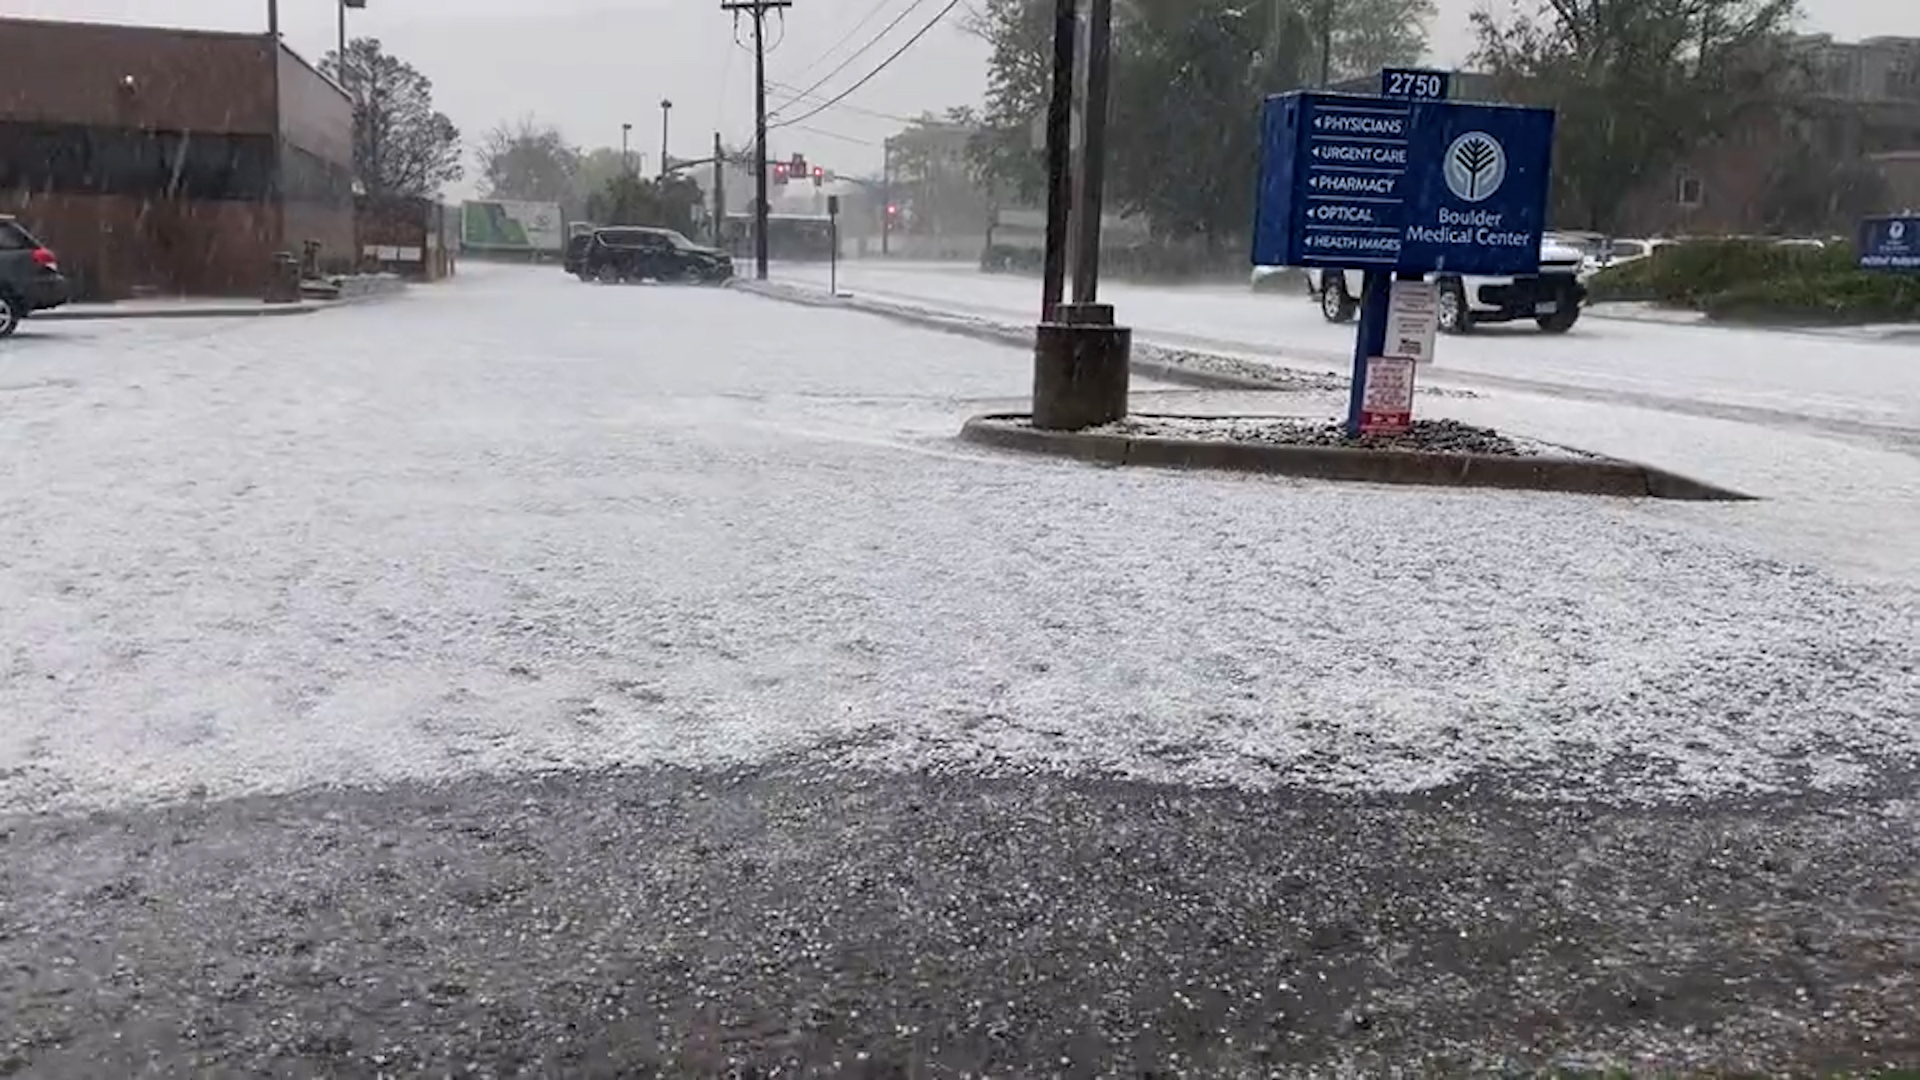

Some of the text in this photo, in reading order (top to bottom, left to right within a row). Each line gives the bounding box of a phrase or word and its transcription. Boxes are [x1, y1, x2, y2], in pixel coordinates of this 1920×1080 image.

[1388, 72, 1441, 97] 2750
[1323, 115, 1402, 133] PHYSICIANS
[1321, 146, 1407, 163] URGENT CARE
[1319, 175, 1395, 193] PHARMACY
[1317, 205, 1373, 221] OPTICAL
[1439, 206, 1502, 226] Boulder
[1314, 235, 1401, 251] HEALTH IMAGES
[1406, 225, 1530, 245] Medical Center
